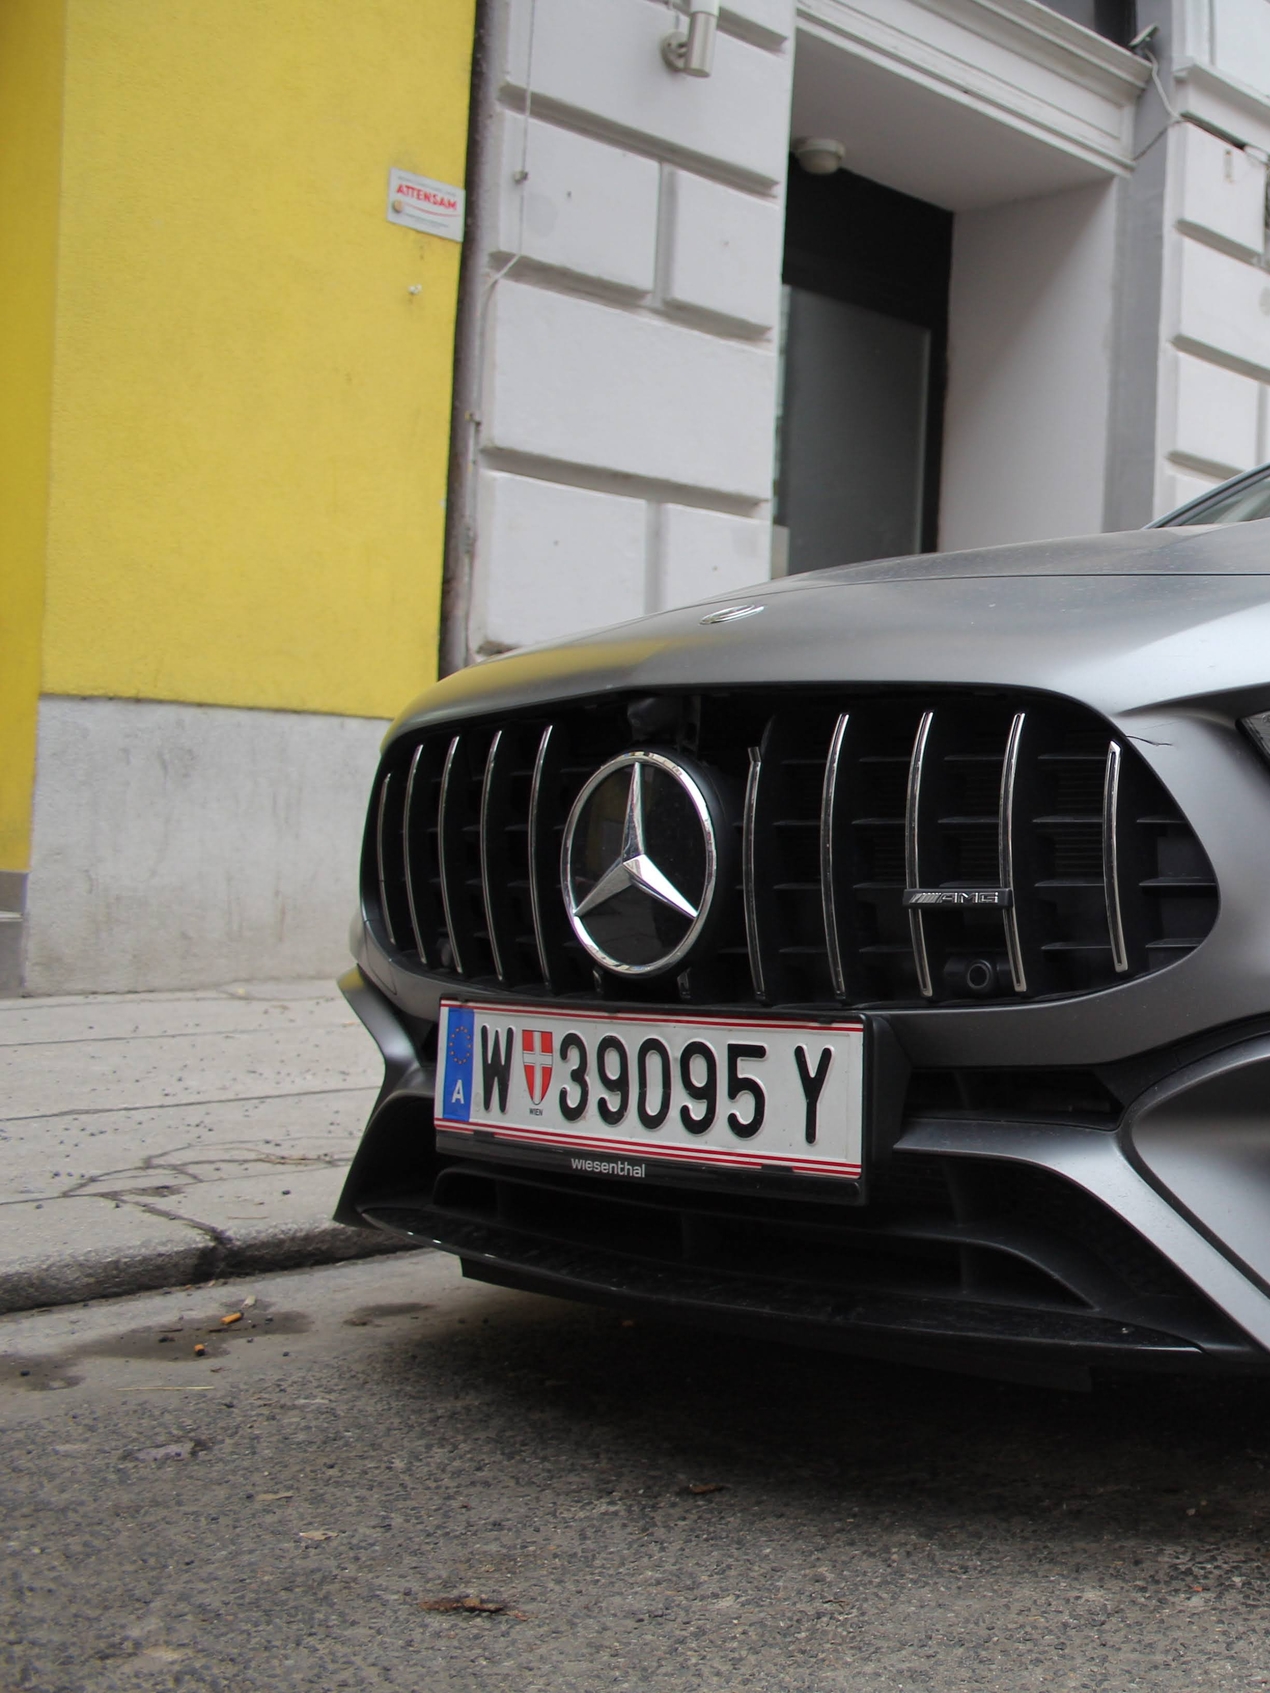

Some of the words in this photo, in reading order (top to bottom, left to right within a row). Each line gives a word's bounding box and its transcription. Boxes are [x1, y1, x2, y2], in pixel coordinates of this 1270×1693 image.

[396, 183, 457, 211] ATTENSAM
[451, 1079, 465, 1105] A
[481, 1024, 515, 1115] W
[559, 1032, 768, 1139] 39095
[794, 1044, 834, 1145] Y
[571, 1158, 646, 1178] wiesenthal
